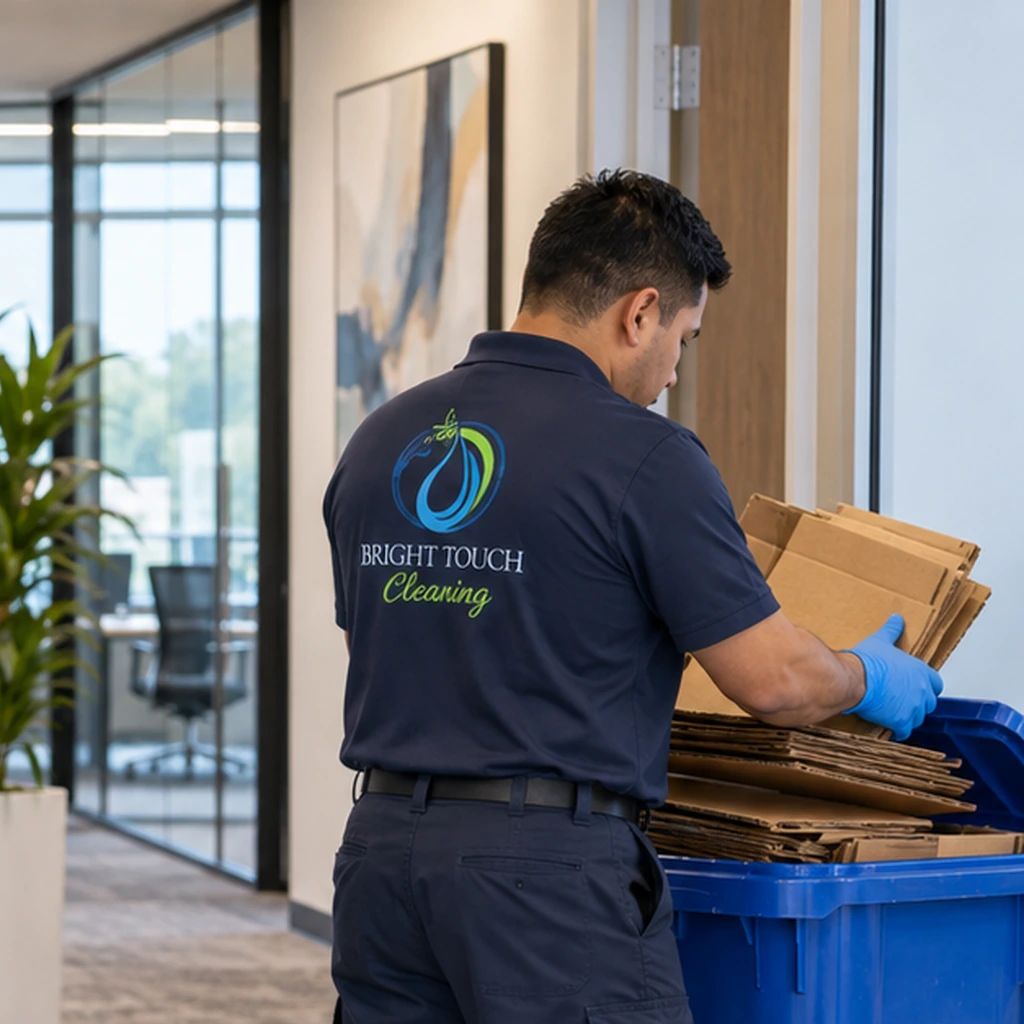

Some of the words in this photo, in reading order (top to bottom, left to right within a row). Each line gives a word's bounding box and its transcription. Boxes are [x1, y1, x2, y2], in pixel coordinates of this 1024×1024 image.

[360, 543, 438, 567] BRIGHT
[442, 545, 524, 574] TOUCH
[382, 571, 492, 618] Cleaning
